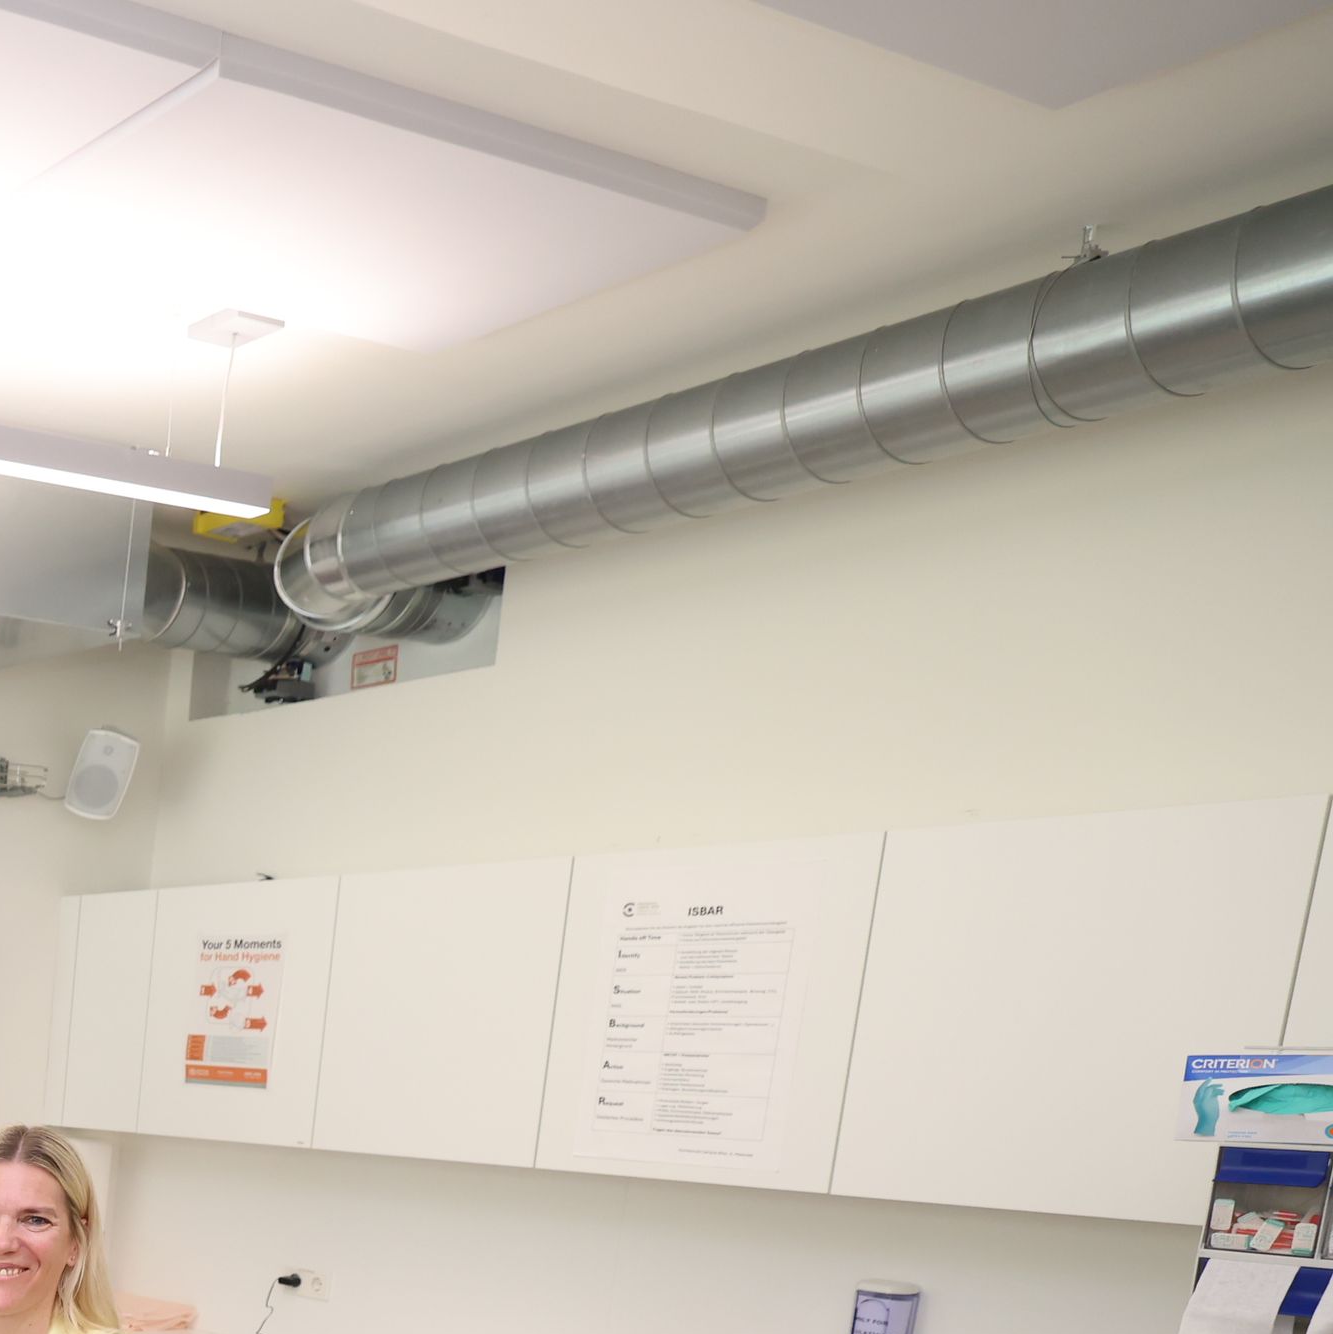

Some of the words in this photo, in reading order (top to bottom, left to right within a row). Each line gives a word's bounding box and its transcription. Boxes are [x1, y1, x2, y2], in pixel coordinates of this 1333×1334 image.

[687, 905, 724, 917] ISBAR
[202, 939, 223, 950] Your
[225, 939, 232, 949] 5
[234, 939, 282, 950] Moments
[200, 952, 212, 961] for
[215, 952, 239, 961] Hand
[242, 952, 281, 963] Hygiene
[1192, 1058, 1276, 1069] CRITERION
